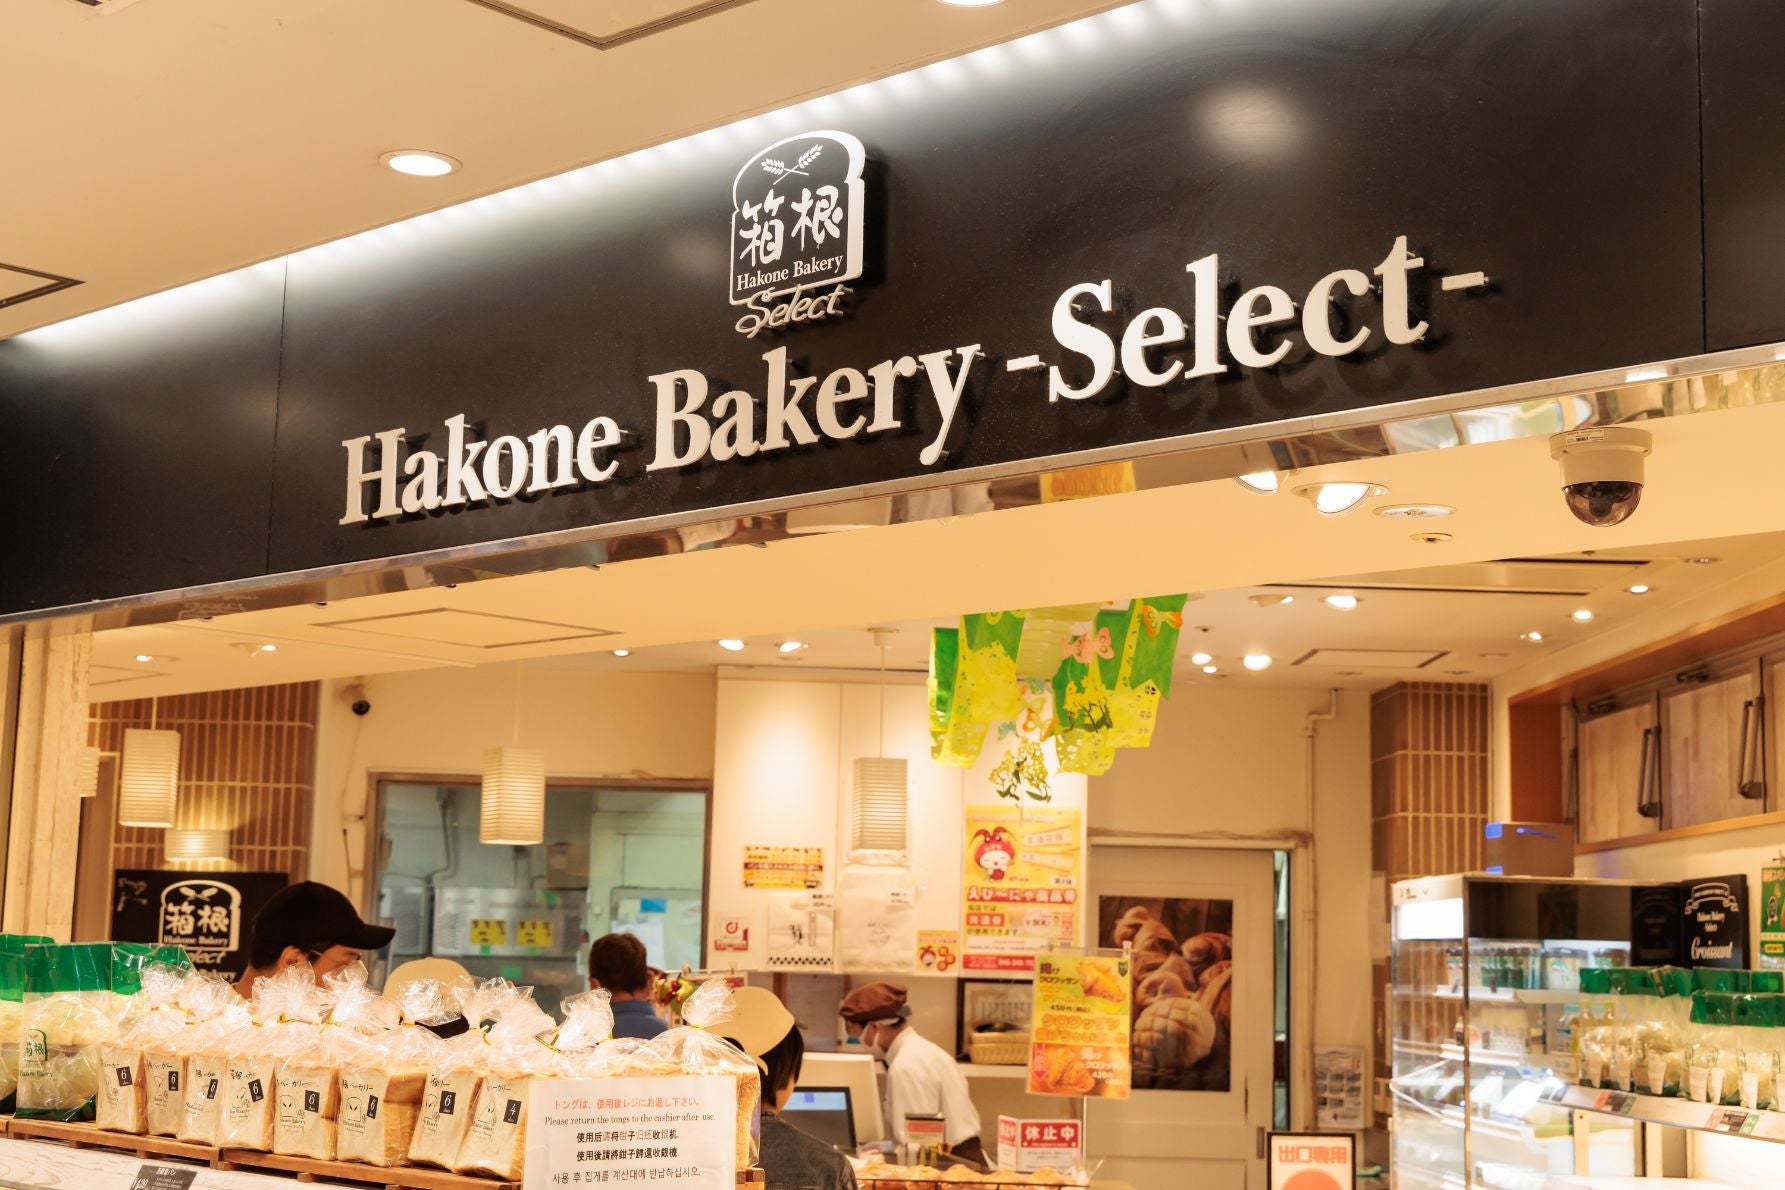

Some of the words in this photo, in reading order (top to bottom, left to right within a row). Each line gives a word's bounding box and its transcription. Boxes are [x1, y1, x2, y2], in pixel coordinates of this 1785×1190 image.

[739, 184, 844, 268] 箱根
[736, 267, 789, 291] Hakone
[793, 254, 844, 279] Bakery
[735, 283, 847, 339] Select
[338, 412, 622, 527] Hakone
[646, 343, 983, 473] Bakery
[121, 1069, 127, 1080] 6
[253, 1082, 259, 1095] 6
[308, 1093, 315, 1105] 6
[370, 1099, 375, 1111] 6
[445, 1094, 452, 1107] 6
[510, 1103, 517, 1116] 4
[544, 1116, 569, 1126] Please
[570, 1116, 595, 1124] return
[597, 1115, 608, 1124] the
[611, 1116, 630, 1126] tongs
[632, 1115, 639, 1123] to
[640, 1114, 653, 1122] the
[654, 1113, 680, 1122] cashier
[681, 1112, 699, 1121] after
[1025, 1125, 1075, 1141] 休止中
[552, 1172, 570, 1185] 사용
[573, 1171, 582, 1183] 후
[585, 1170, 610, 1183] 집게를
[613, 1168, 647, 1181] 계산대에
